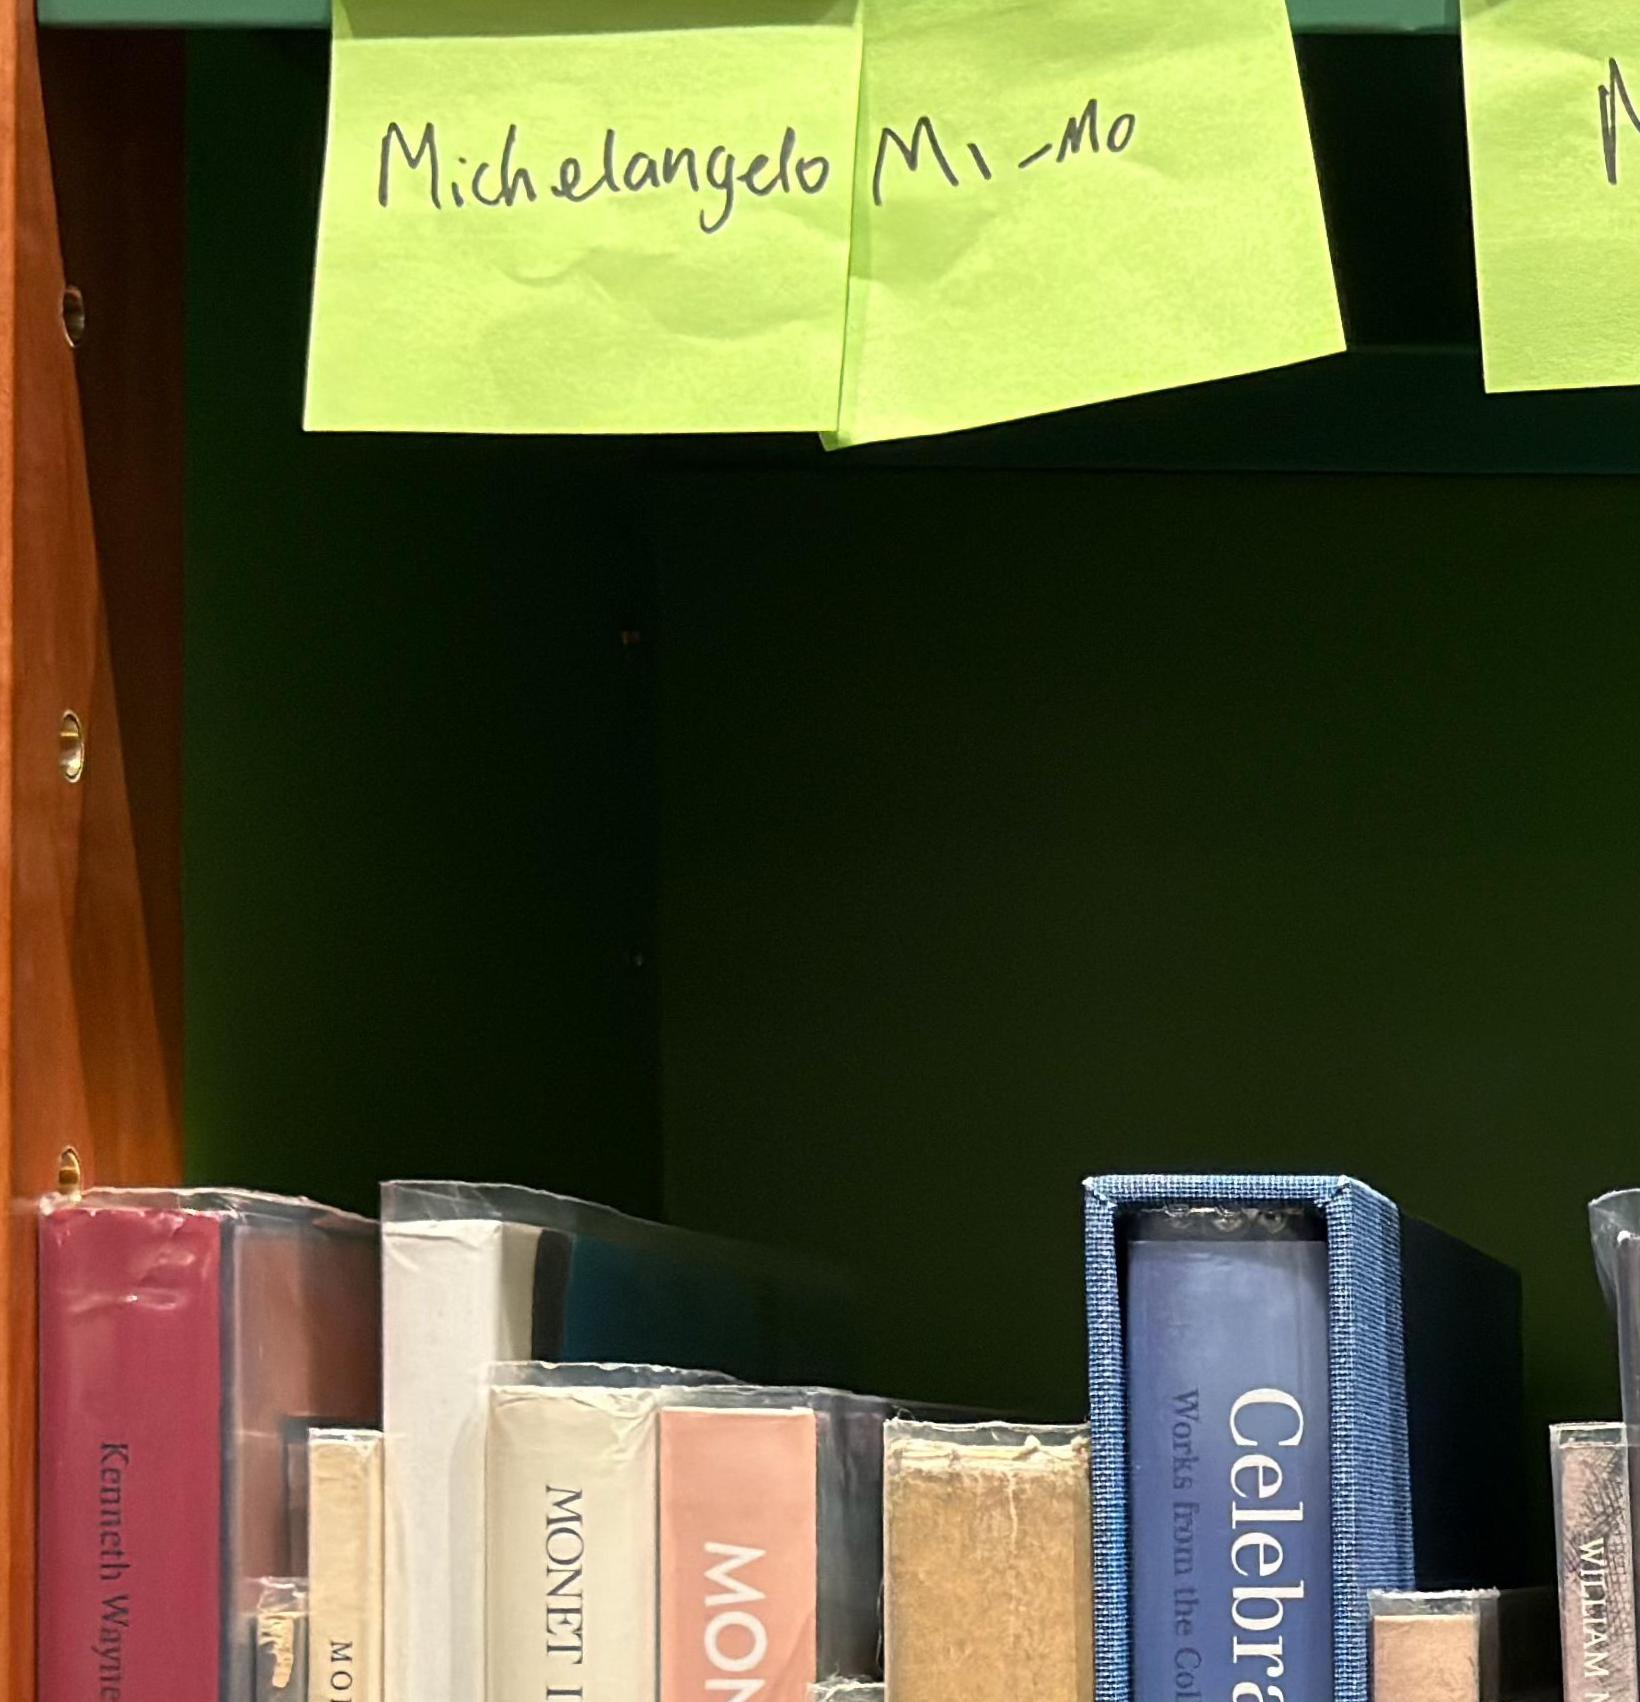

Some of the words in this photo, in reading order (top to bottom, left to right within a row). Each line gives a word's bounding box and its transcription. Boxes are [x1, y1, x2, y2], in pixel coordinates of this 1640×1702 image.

[377, 120, 829, 235] Michelangelo
[1170, 1388, 1200, 1491] Works
[99, 1441, 131, 1581] Kenneth
[1171, 1501, 1201, 1577] from
[544, 1485, 585, 1664] MONET
[1171, 1587, 1201, 1637] the
[1578, 1536, 1609, 1679] WILLIAM
